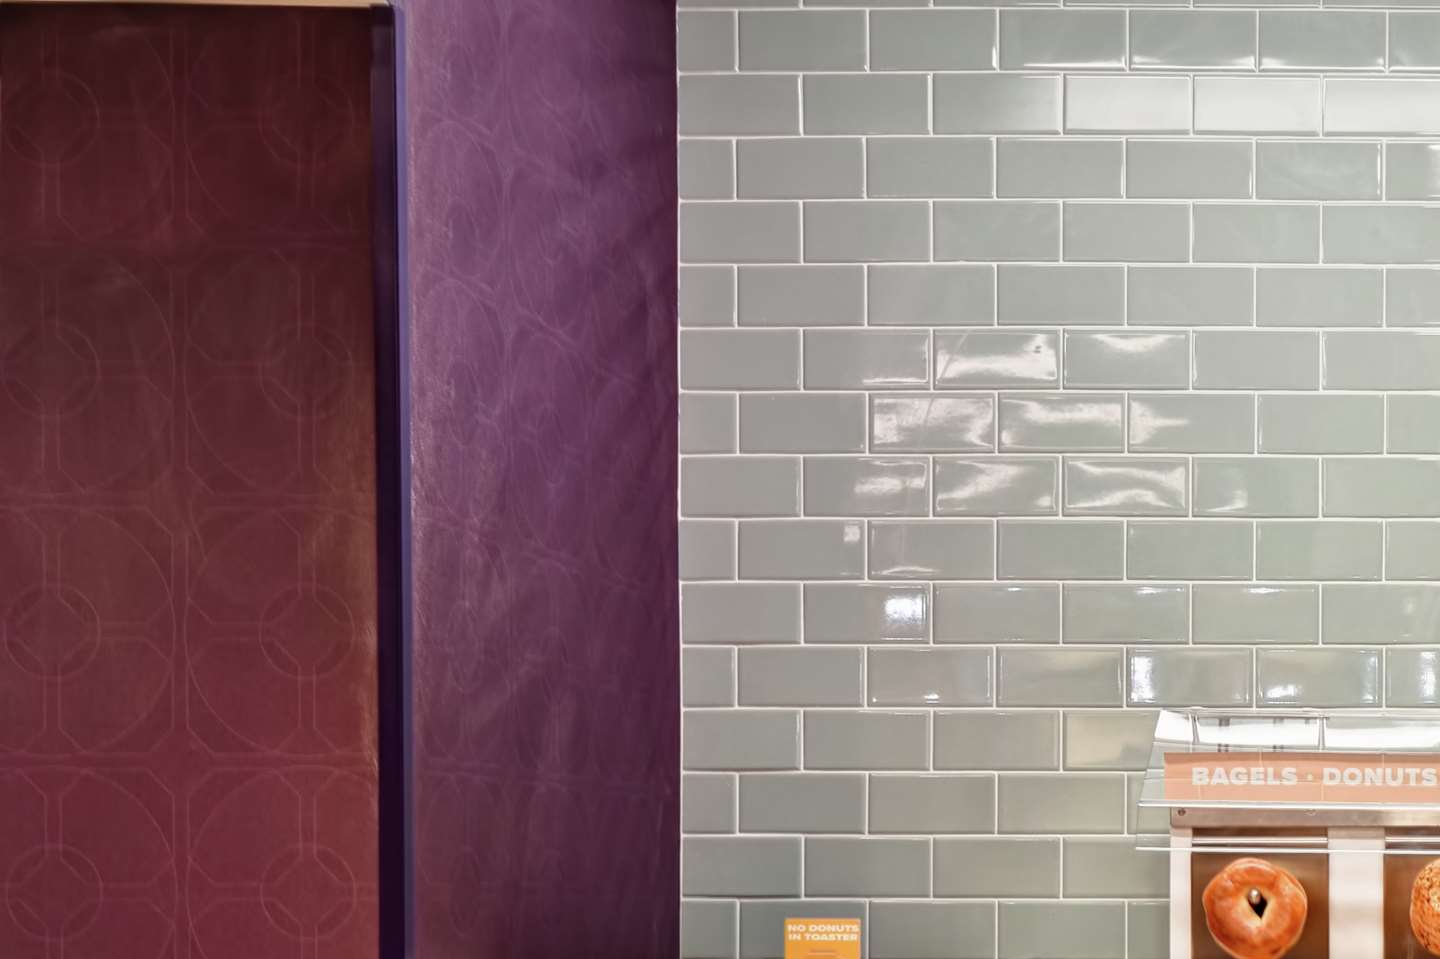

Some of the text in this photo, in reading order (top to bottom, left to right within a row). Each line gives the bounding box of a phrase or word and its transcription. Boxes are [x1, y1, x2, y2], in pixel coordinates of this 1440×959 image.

[1191, 766, 1298, 786] BAGELS
[1322, 766, 1439, 786] DONUTS
[787, 924, 860, 933] NO DONUTS
[787, 933, 858, 941] IN TOASTER
